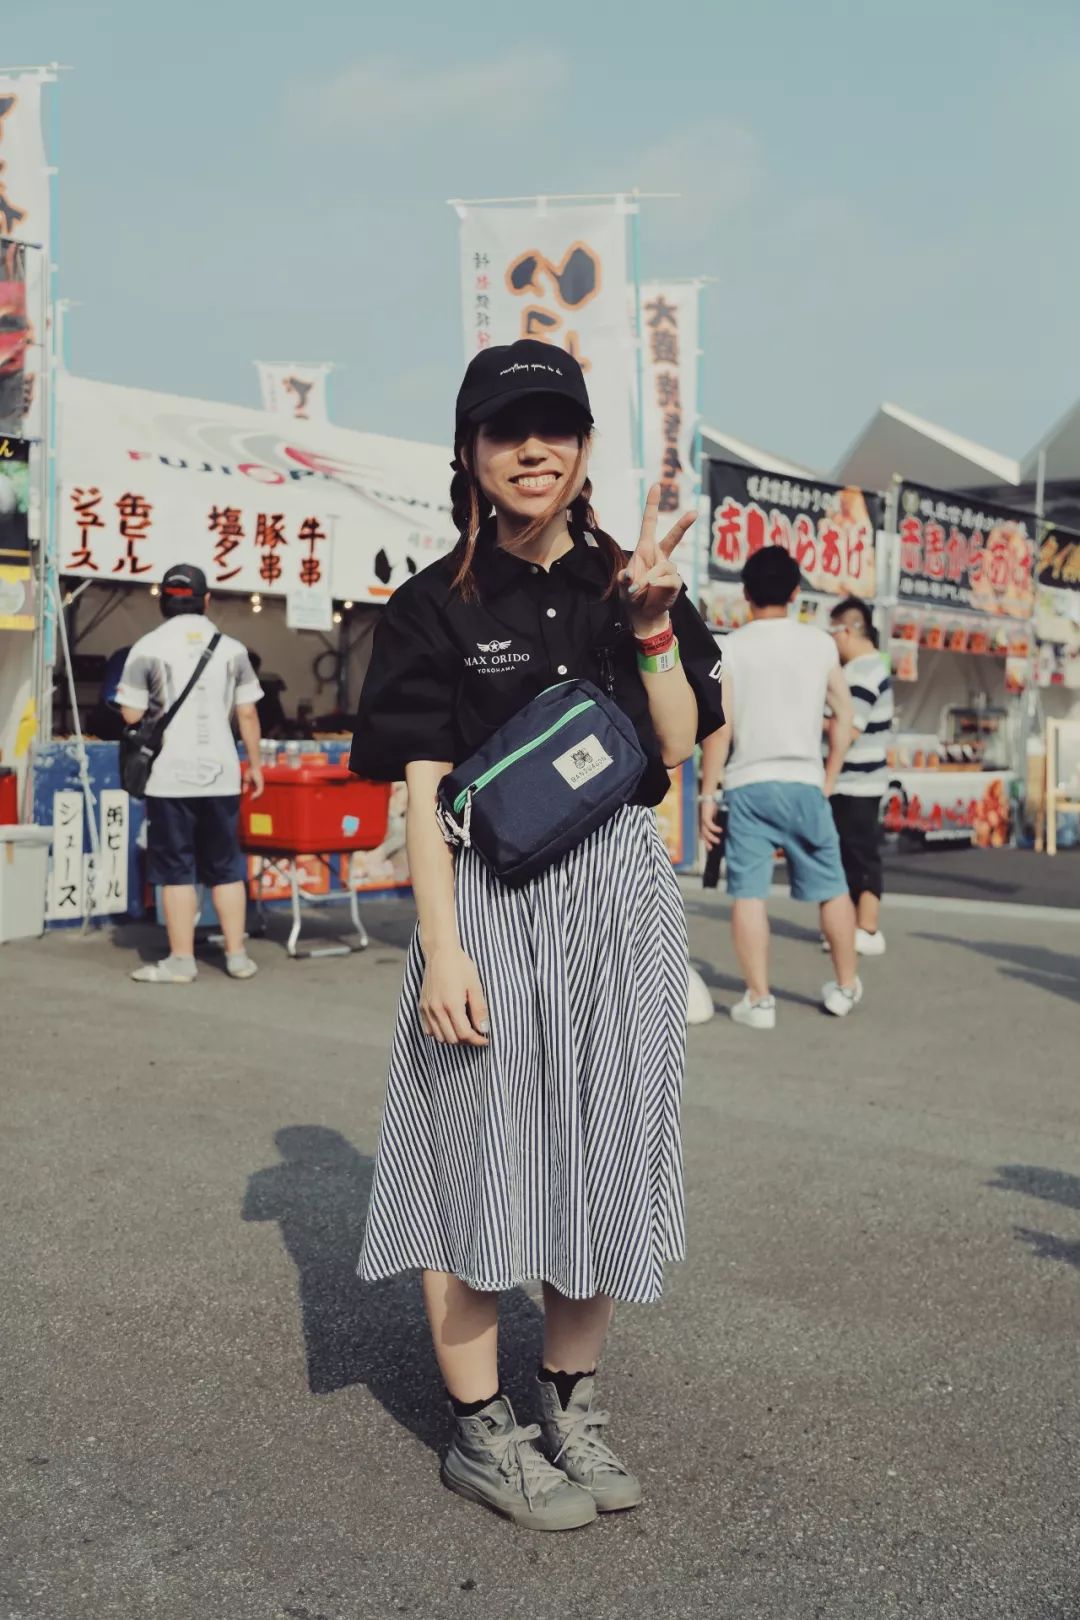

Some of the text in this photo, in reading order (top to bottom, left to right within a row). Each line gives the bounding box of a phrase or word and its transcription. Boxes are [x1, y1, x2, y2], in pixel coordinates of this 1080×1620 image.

[66, 487, 104, 570] ジュース
[112, 492, 153, 574] 缶ビール
[207, 505, 245, 582] 塩タン
[255, 513, 287, 586] 豚串
[297, 516, 326, 587] 牛串
[464, 653, 530, 667] MAX ORIDO
[477, 665, 516, 674] YOKOHAMA
